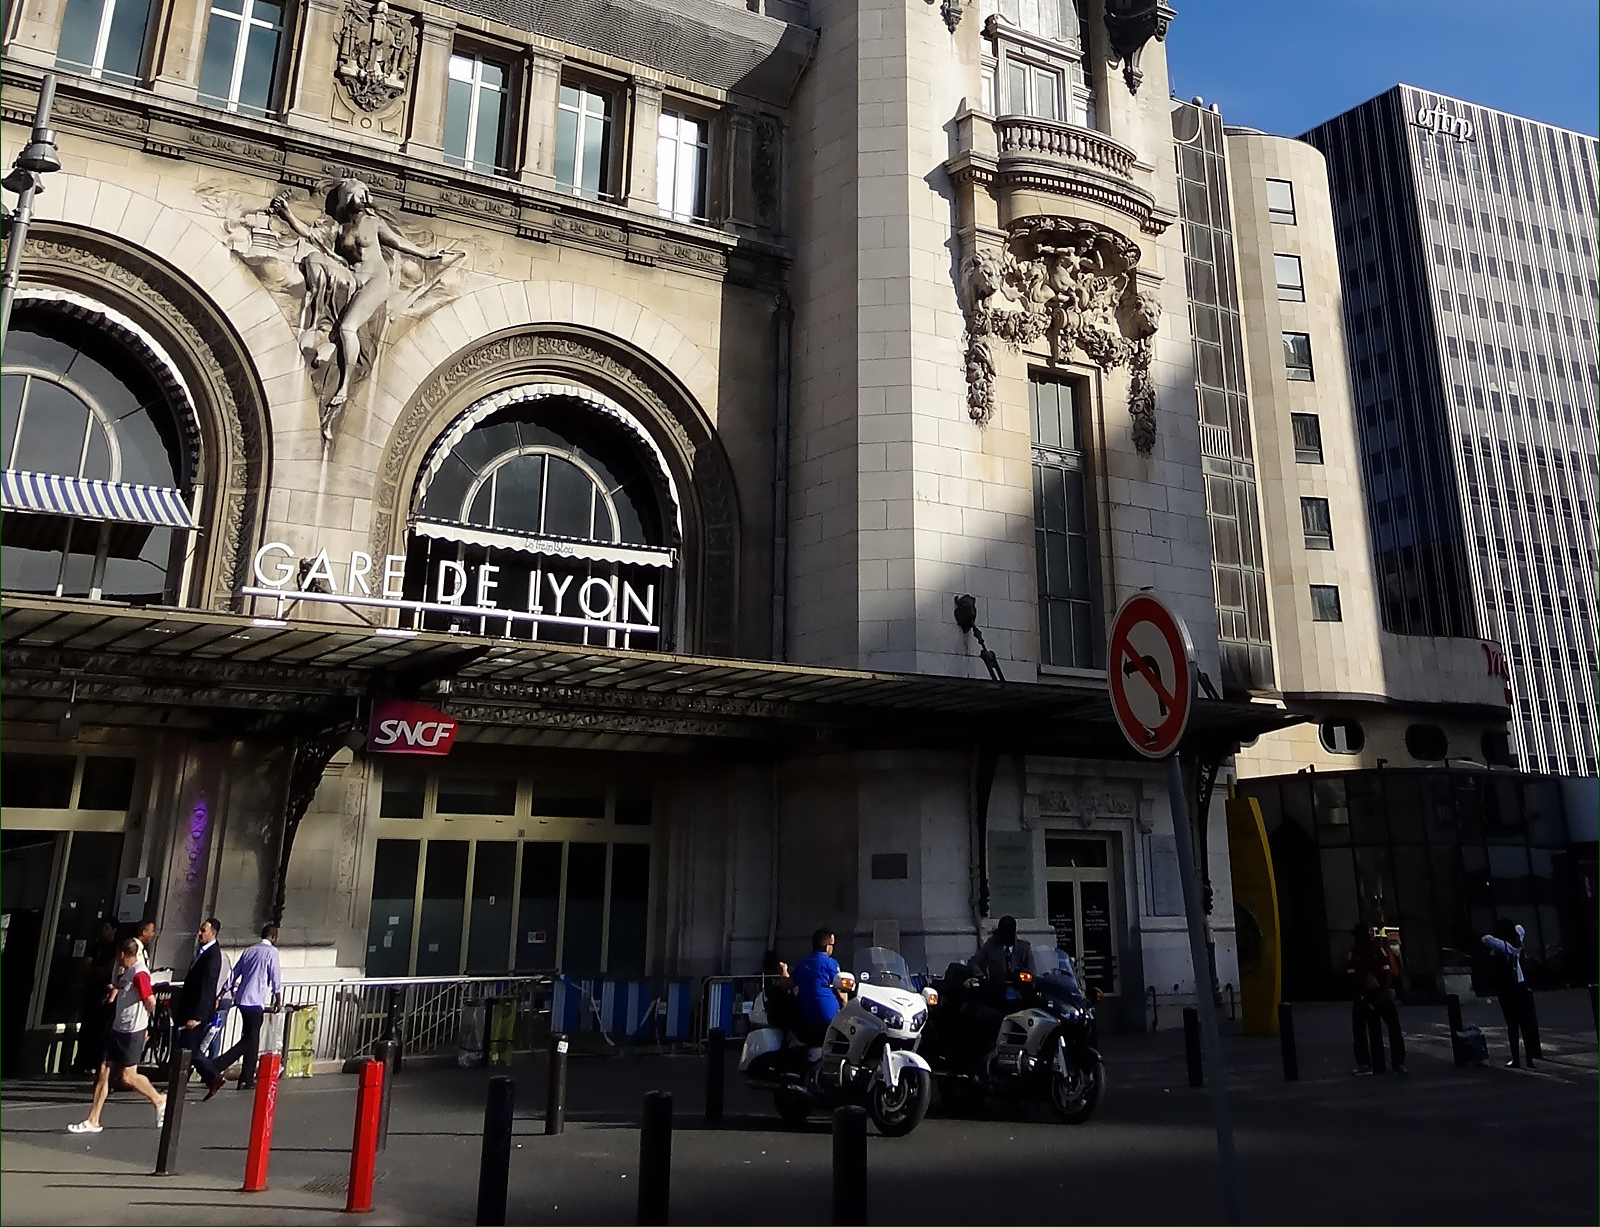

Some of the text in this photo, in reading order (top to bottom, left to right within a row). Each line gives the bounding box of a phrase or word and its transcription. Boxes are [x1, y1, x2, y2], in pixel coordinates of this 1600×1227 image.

[253, 541, 655, 625] GARE DE LYON
[374, 719, 455, 747] SNCF
